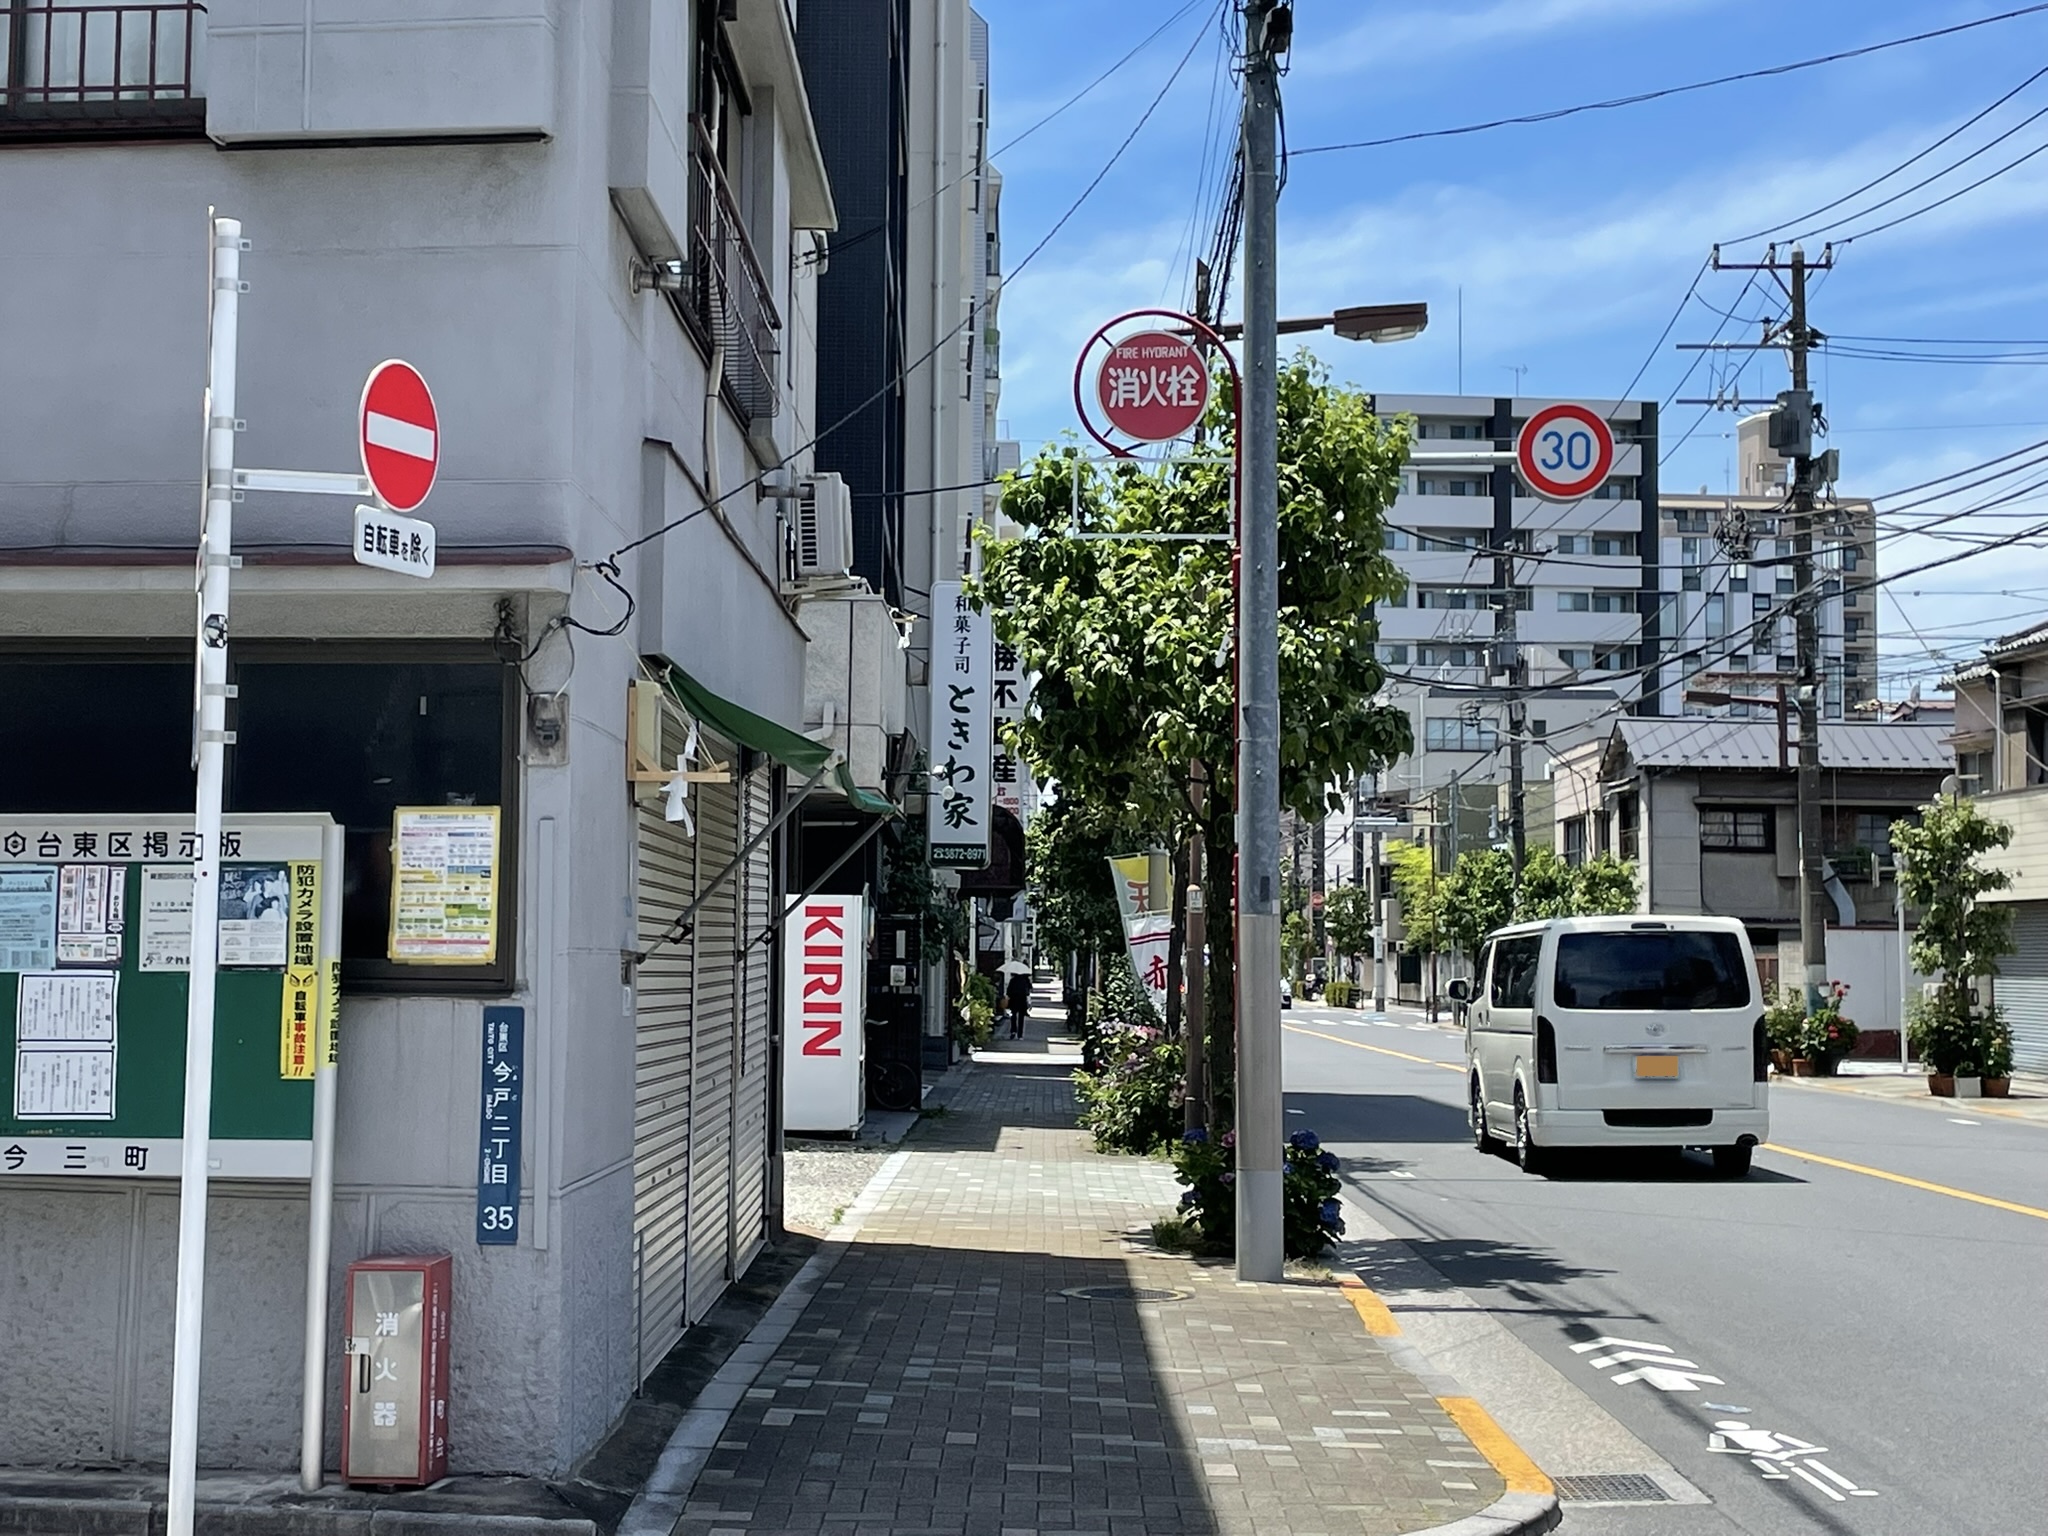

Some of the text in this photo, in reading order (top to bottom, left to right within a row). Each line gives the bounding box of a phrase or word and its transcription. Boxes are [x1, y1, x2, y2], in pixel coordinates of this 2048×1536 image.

[1116, 346, 1189, 359] FIRE HYDRANT
[1108, 365, 1200, 408] 消火栓
[1541, 431, 1591, 470] 30
[363, 522, 429, 566] 自転車を除く
[953, 594, 971, 674] 和菓子司
[943, 684, 978, 829] ときわ家
[37, 831, 242, 858] 台東区掲示板
[294, 864, 316, 966] 防犯カメラ設置地域
[802, 906, 844, 1057] KIRIN
[491, 1061, 512, 1184] 今戸二丁目
[4, 1144, 149, 1171] 今三町
[482, 1206, 513, 1230] 35
[373, 1311, 399, 1427] 消火器
